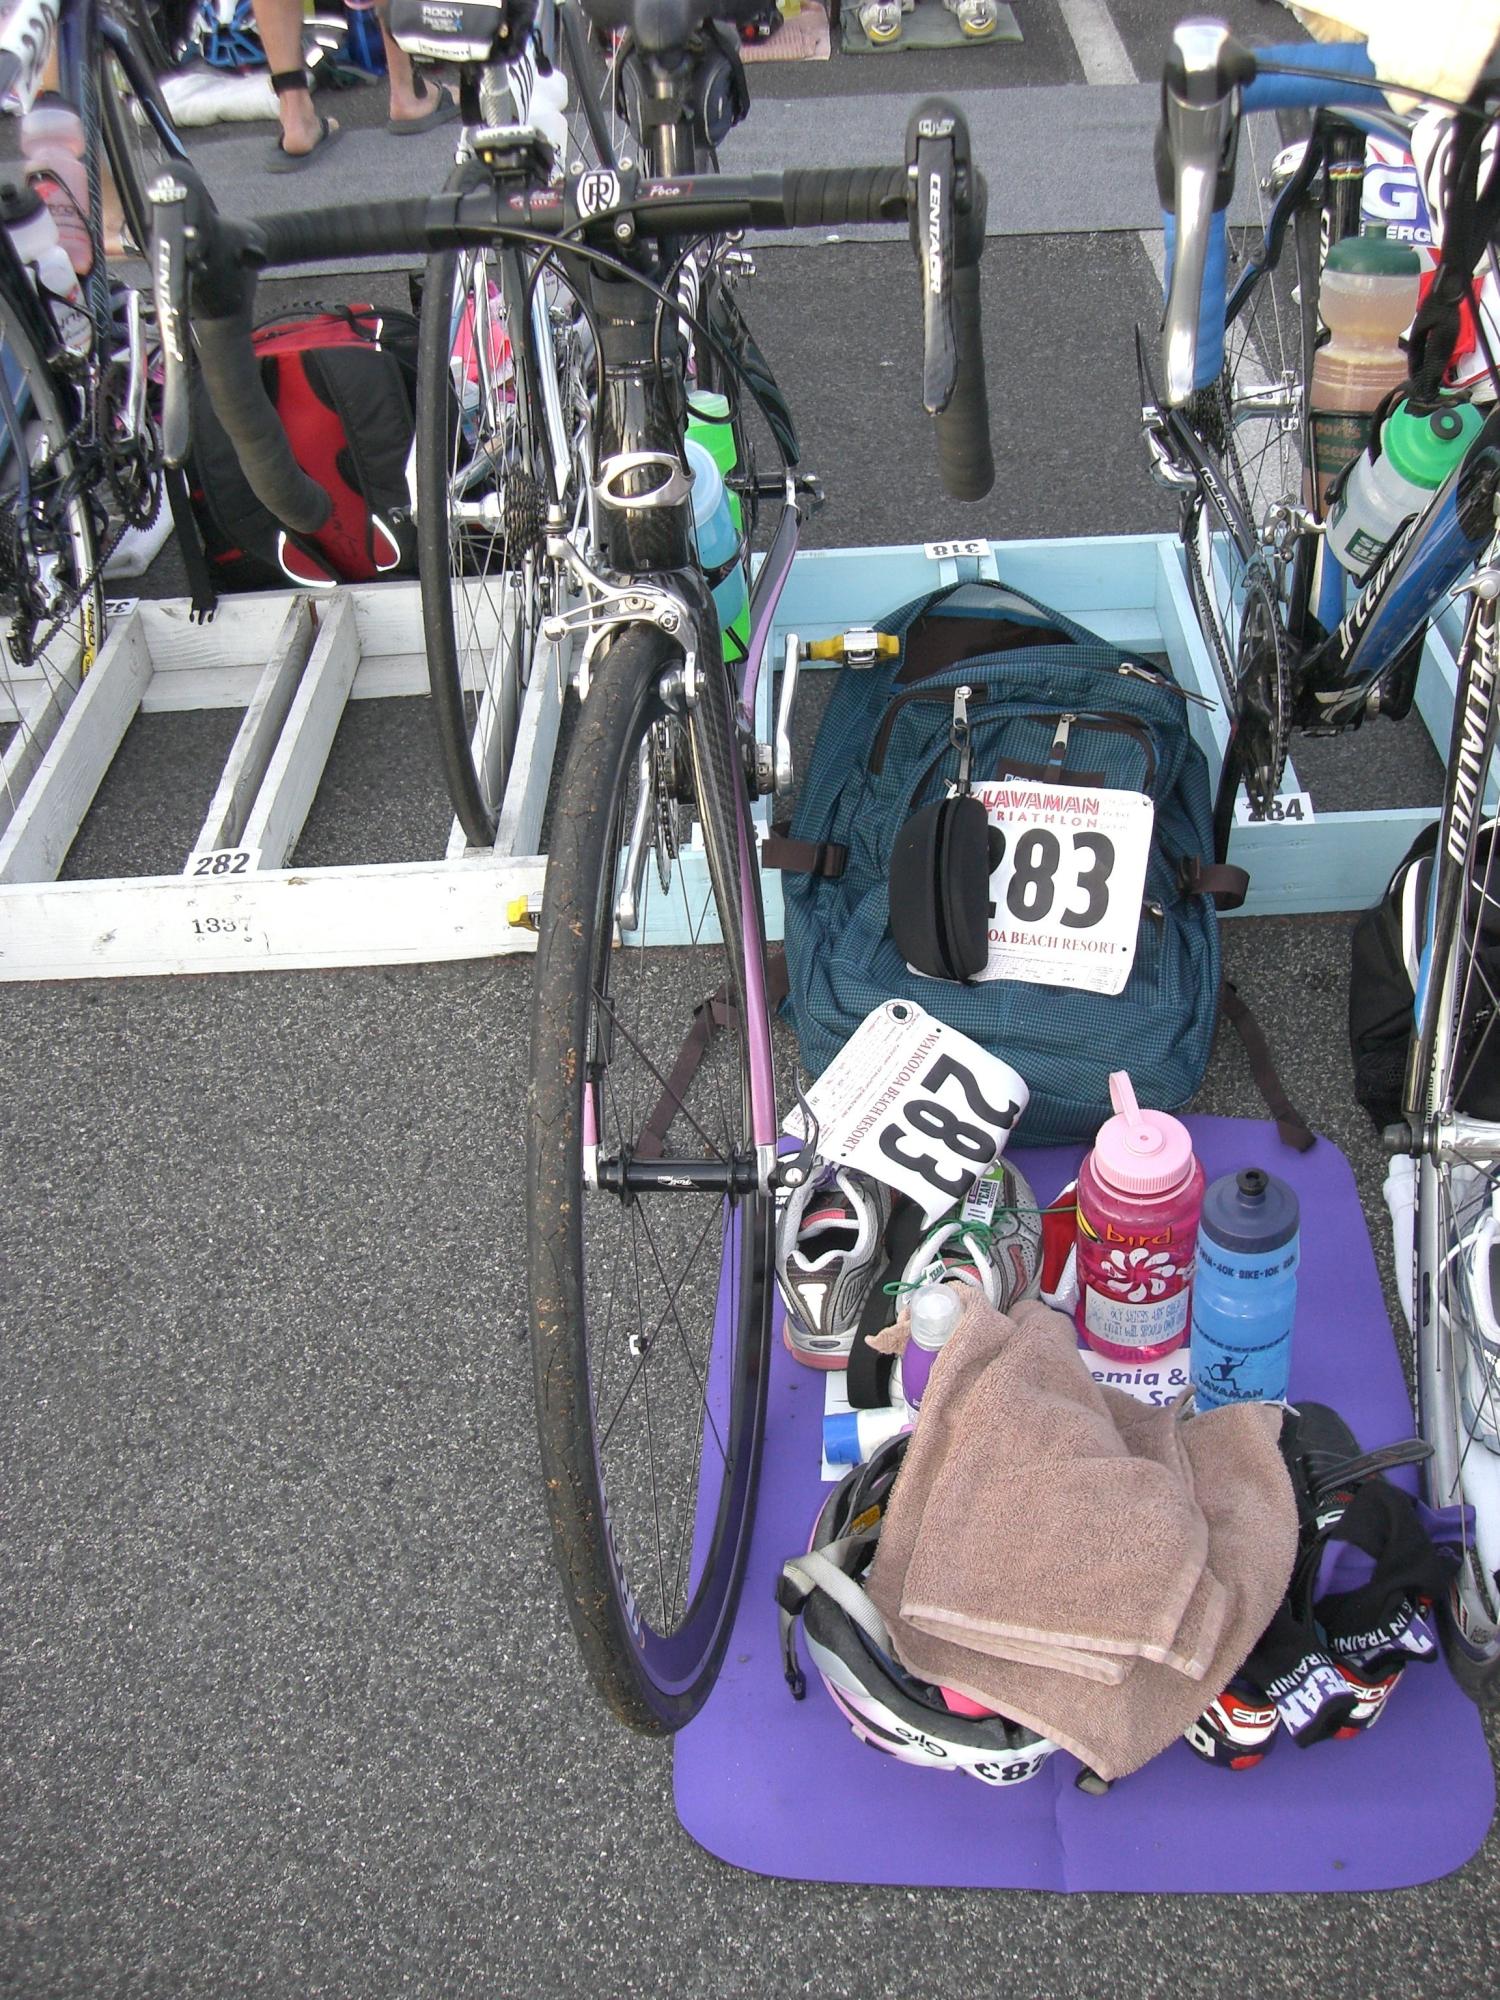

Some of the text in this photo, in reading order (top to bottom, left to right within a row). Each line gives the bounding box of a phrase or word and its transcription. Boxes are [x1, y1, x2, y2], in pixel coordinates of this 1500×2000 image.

[422, 6, 464, 18] ROCKY
[930, 172, 942, 294] CENTAUR
[932, 543, 981, 556] 318
[1447, 606, 1496, 867] SPECIALIZED
[983, 789, 1100, 816] LAVAMAN
[192, 852, 251, 877] 282
[1011, 931, 1058, 949] BEACH
[1062, 937, 1117, 956] RESORT
[892, 1032, 941, 1088] WAIKOLOA
[869, 1085, 901, 1117] BEACH
[842, 1114, 878, 1153] RESORT
[878, 1052, 1021, 1201] 283
[976, 1180, 993, 1206] TEAM
[1106, 1223, 1171, 1247] bird
[928, 1263, 944, 1282] TEAM
[1238, 1263, 1280, 1280] BIKE-10K
[1167, 1368, 1188, 1386] &
[1199, 1374, 1264, 1400] LAVAMAN
[1389, 1612, 1409, 1636] IN
[895, 1727, 948, 1758] Giro
